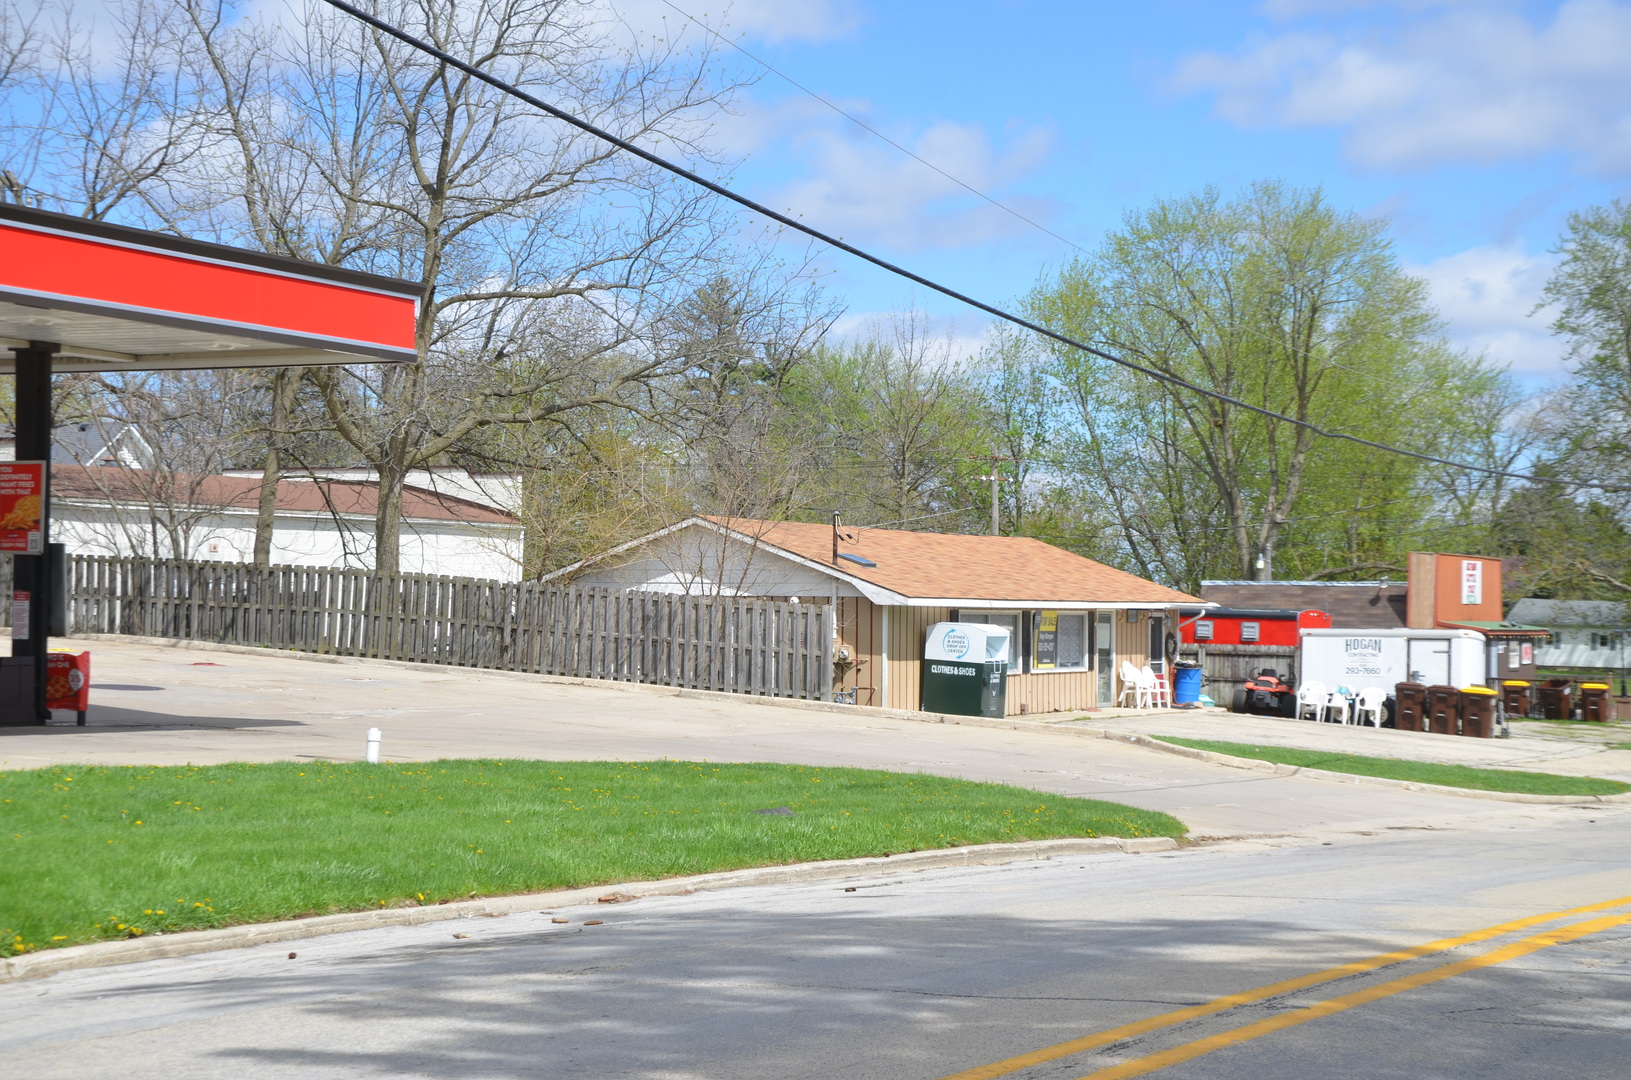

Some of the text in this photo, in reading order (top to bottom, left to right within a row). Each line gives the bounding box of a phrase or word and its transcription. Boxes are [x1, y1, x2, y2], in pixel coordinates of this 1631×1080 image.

[1345, 639, 1381, 653] HOGAN
[931, 664, 976, 676] CLOTHES & SHOES
